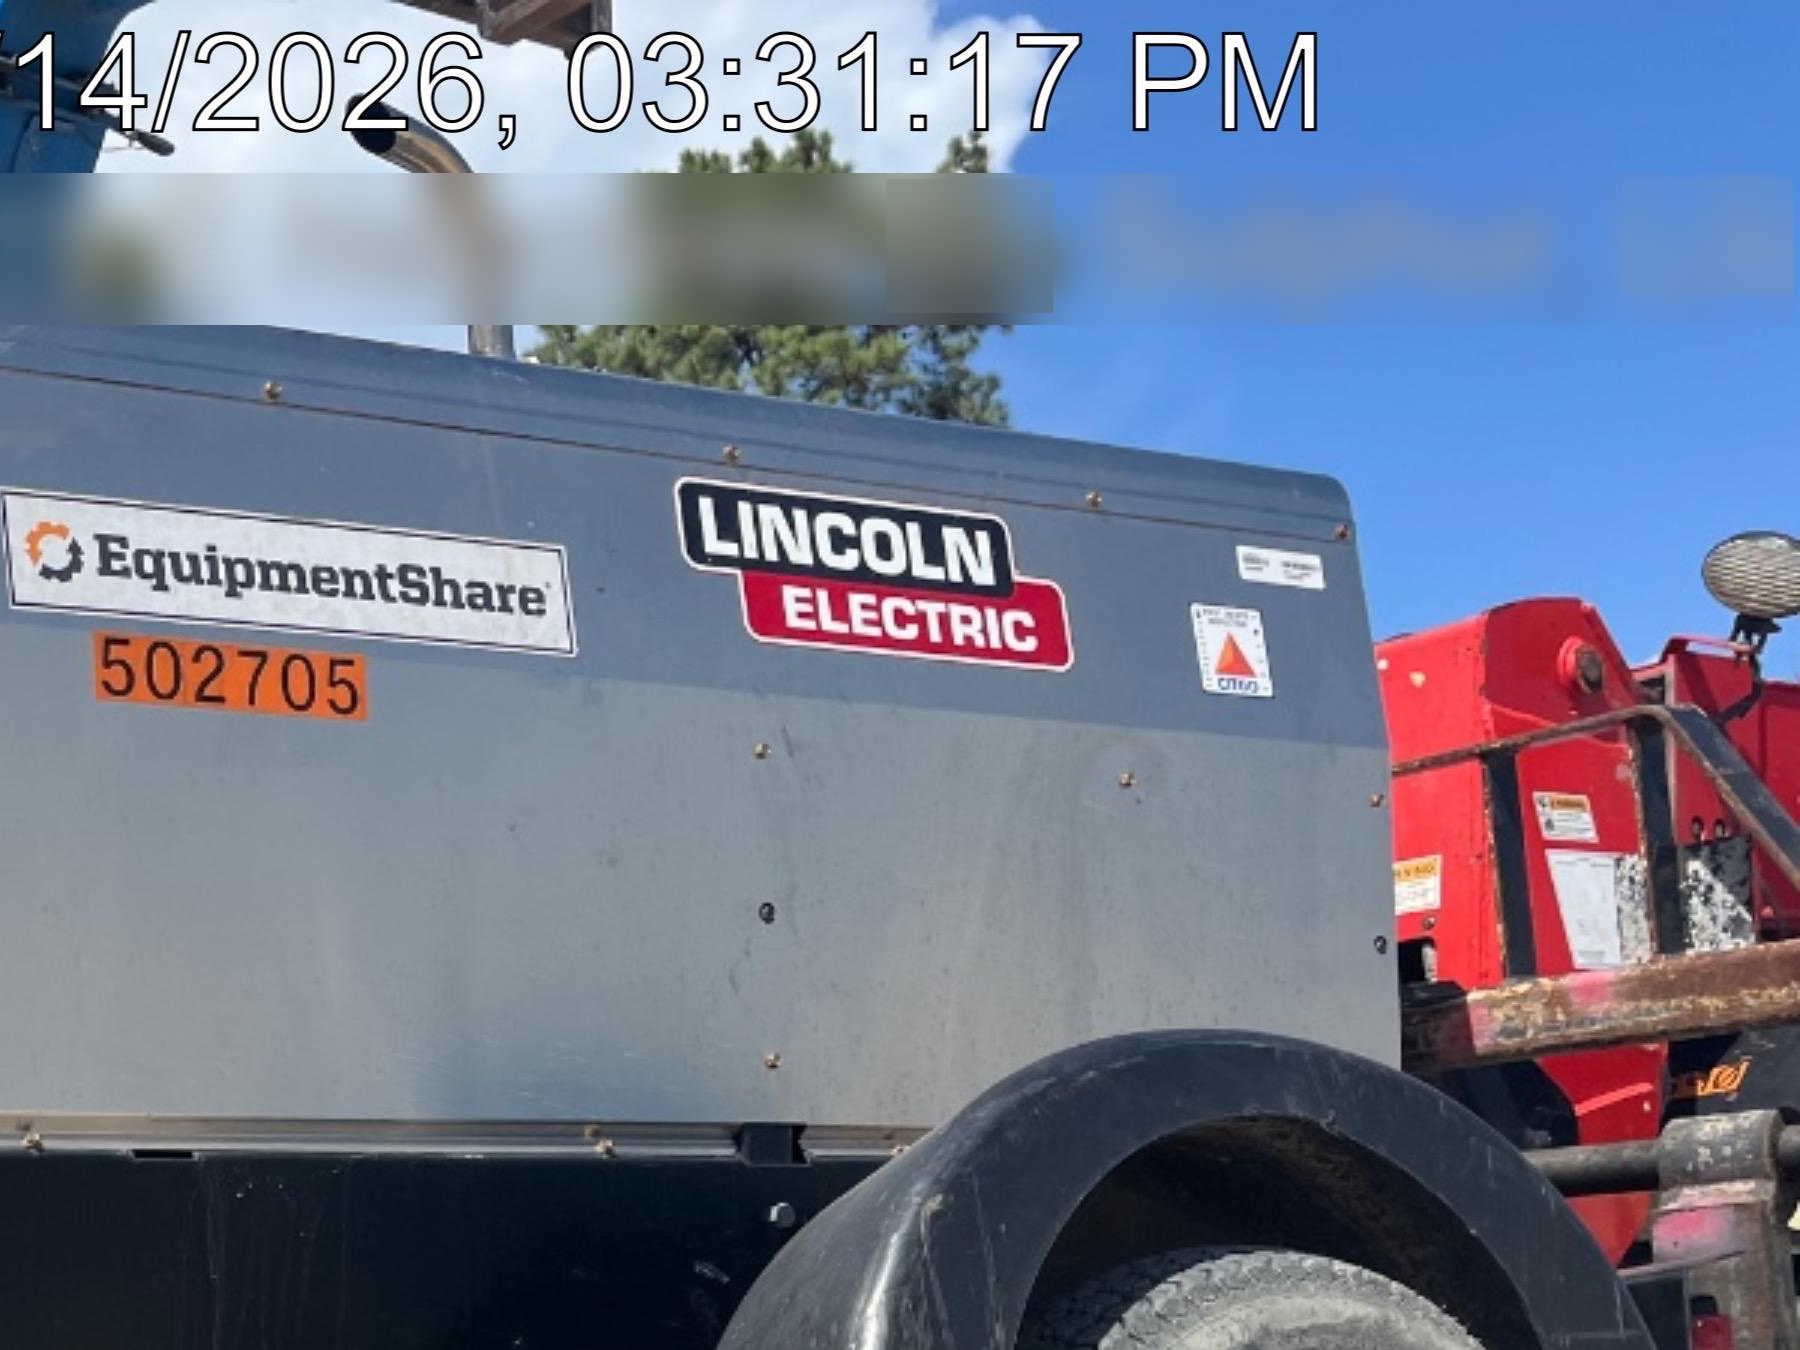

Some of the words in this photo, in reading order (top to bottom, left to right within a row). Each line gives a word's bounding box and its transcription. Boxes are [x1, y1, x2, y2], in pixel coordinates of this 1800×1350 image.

[93, 533, 547, 618] EquipmentShare
[697, 494, 997, 587] LINCOLN
[782, 586, 1038, 654] ELECTRIC
[100, 637, 360, 716] 502705
